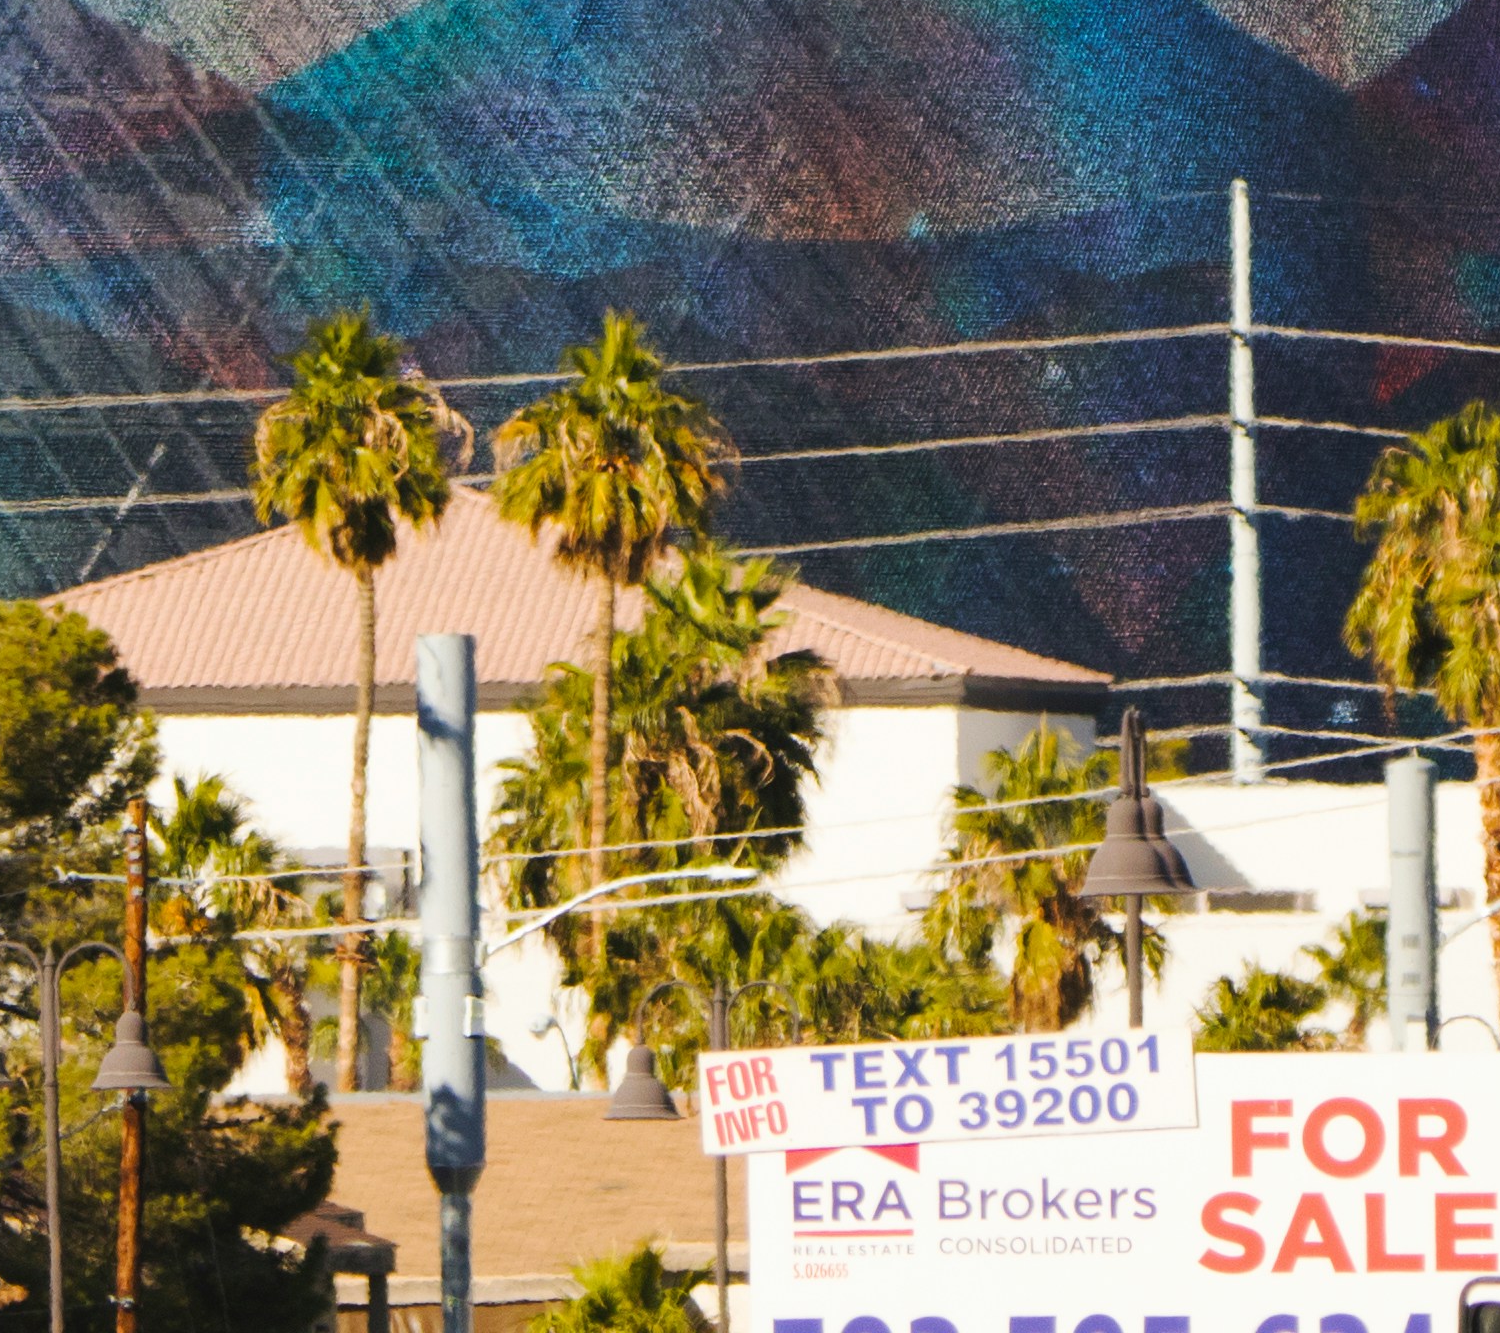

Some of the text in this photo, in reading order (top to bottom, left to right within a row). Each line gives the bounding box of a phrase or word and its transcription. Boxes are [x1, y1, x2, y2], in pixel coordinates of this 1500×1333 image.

[705, 1056, 778, 1106] FOR
[810, 1034, 1160, 1091] TEXT 15501
[713, 1100, 789, 1147] INFO
[851, 1082, 1139, 1136] TO 39200
[1230, 1096, 1470, 1179] FOR
[792, 1177, 1158, 1222] ERA Brokers
[793, 1244, 915, 1256] REAL ESTATE
[938, 1236, 1133, 1255] CONSOLIDATED
[1198, 1191, 1499, 1274] SALE
